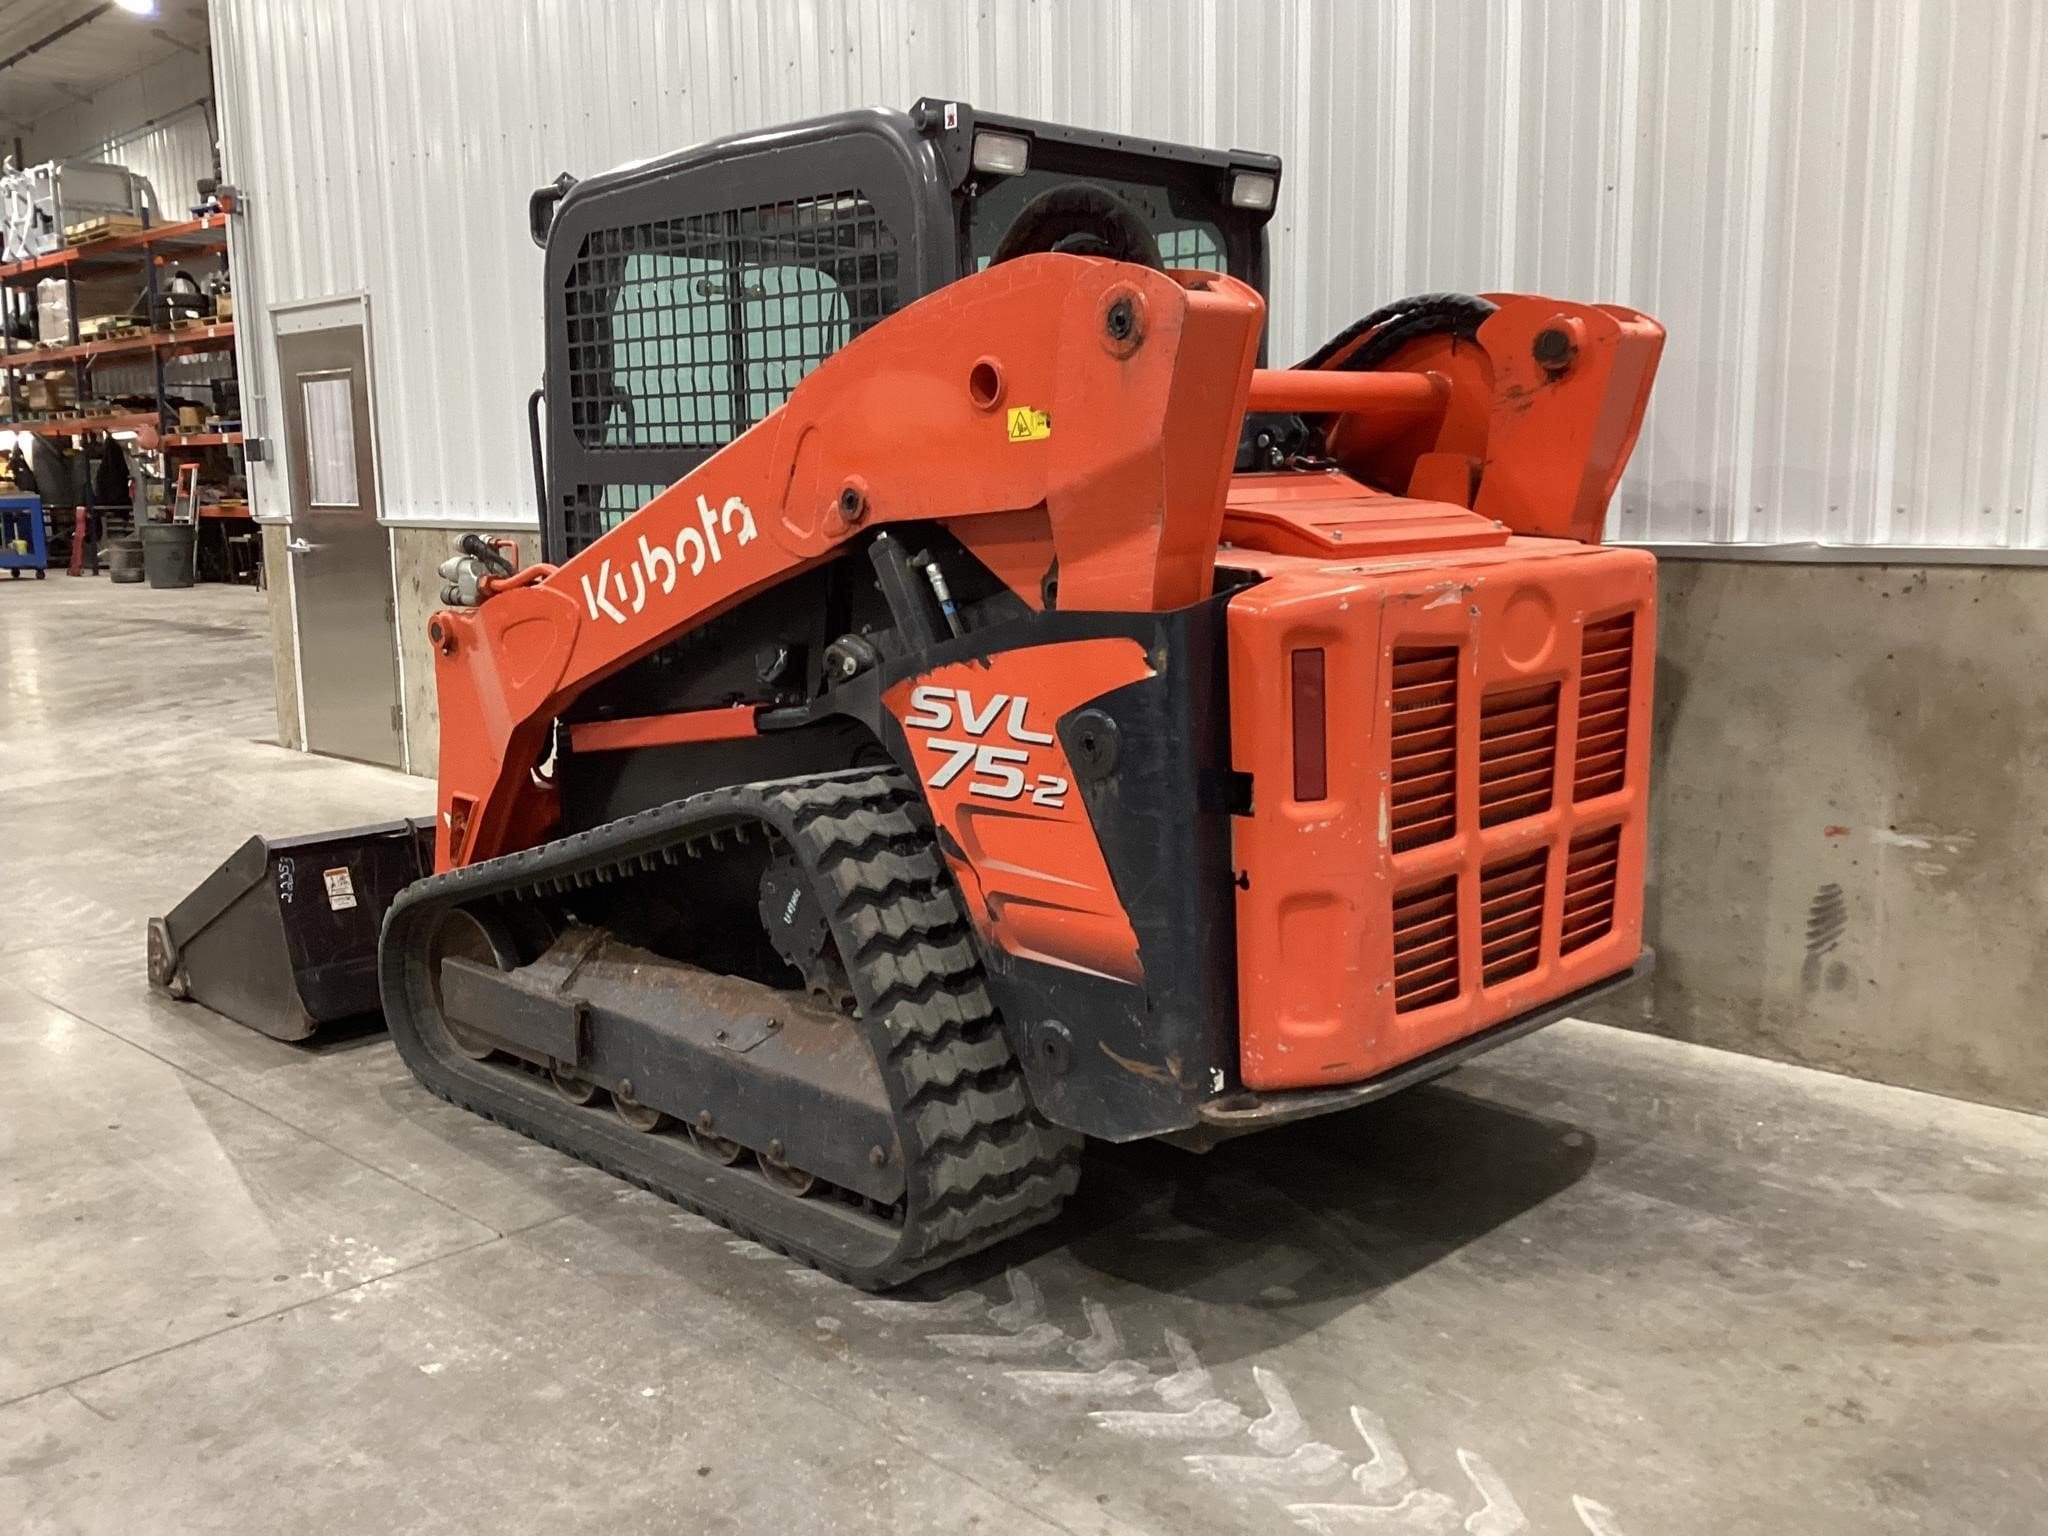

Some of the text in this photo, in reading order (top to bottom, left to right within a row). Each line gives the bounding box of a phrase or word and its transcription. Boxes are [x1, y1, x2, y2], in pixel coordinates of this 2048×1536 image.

[580, 494, 758, 624] Kubota
[904, 685, 1054, 745] SVL
[926, 736, 1069, 808] 75-2
